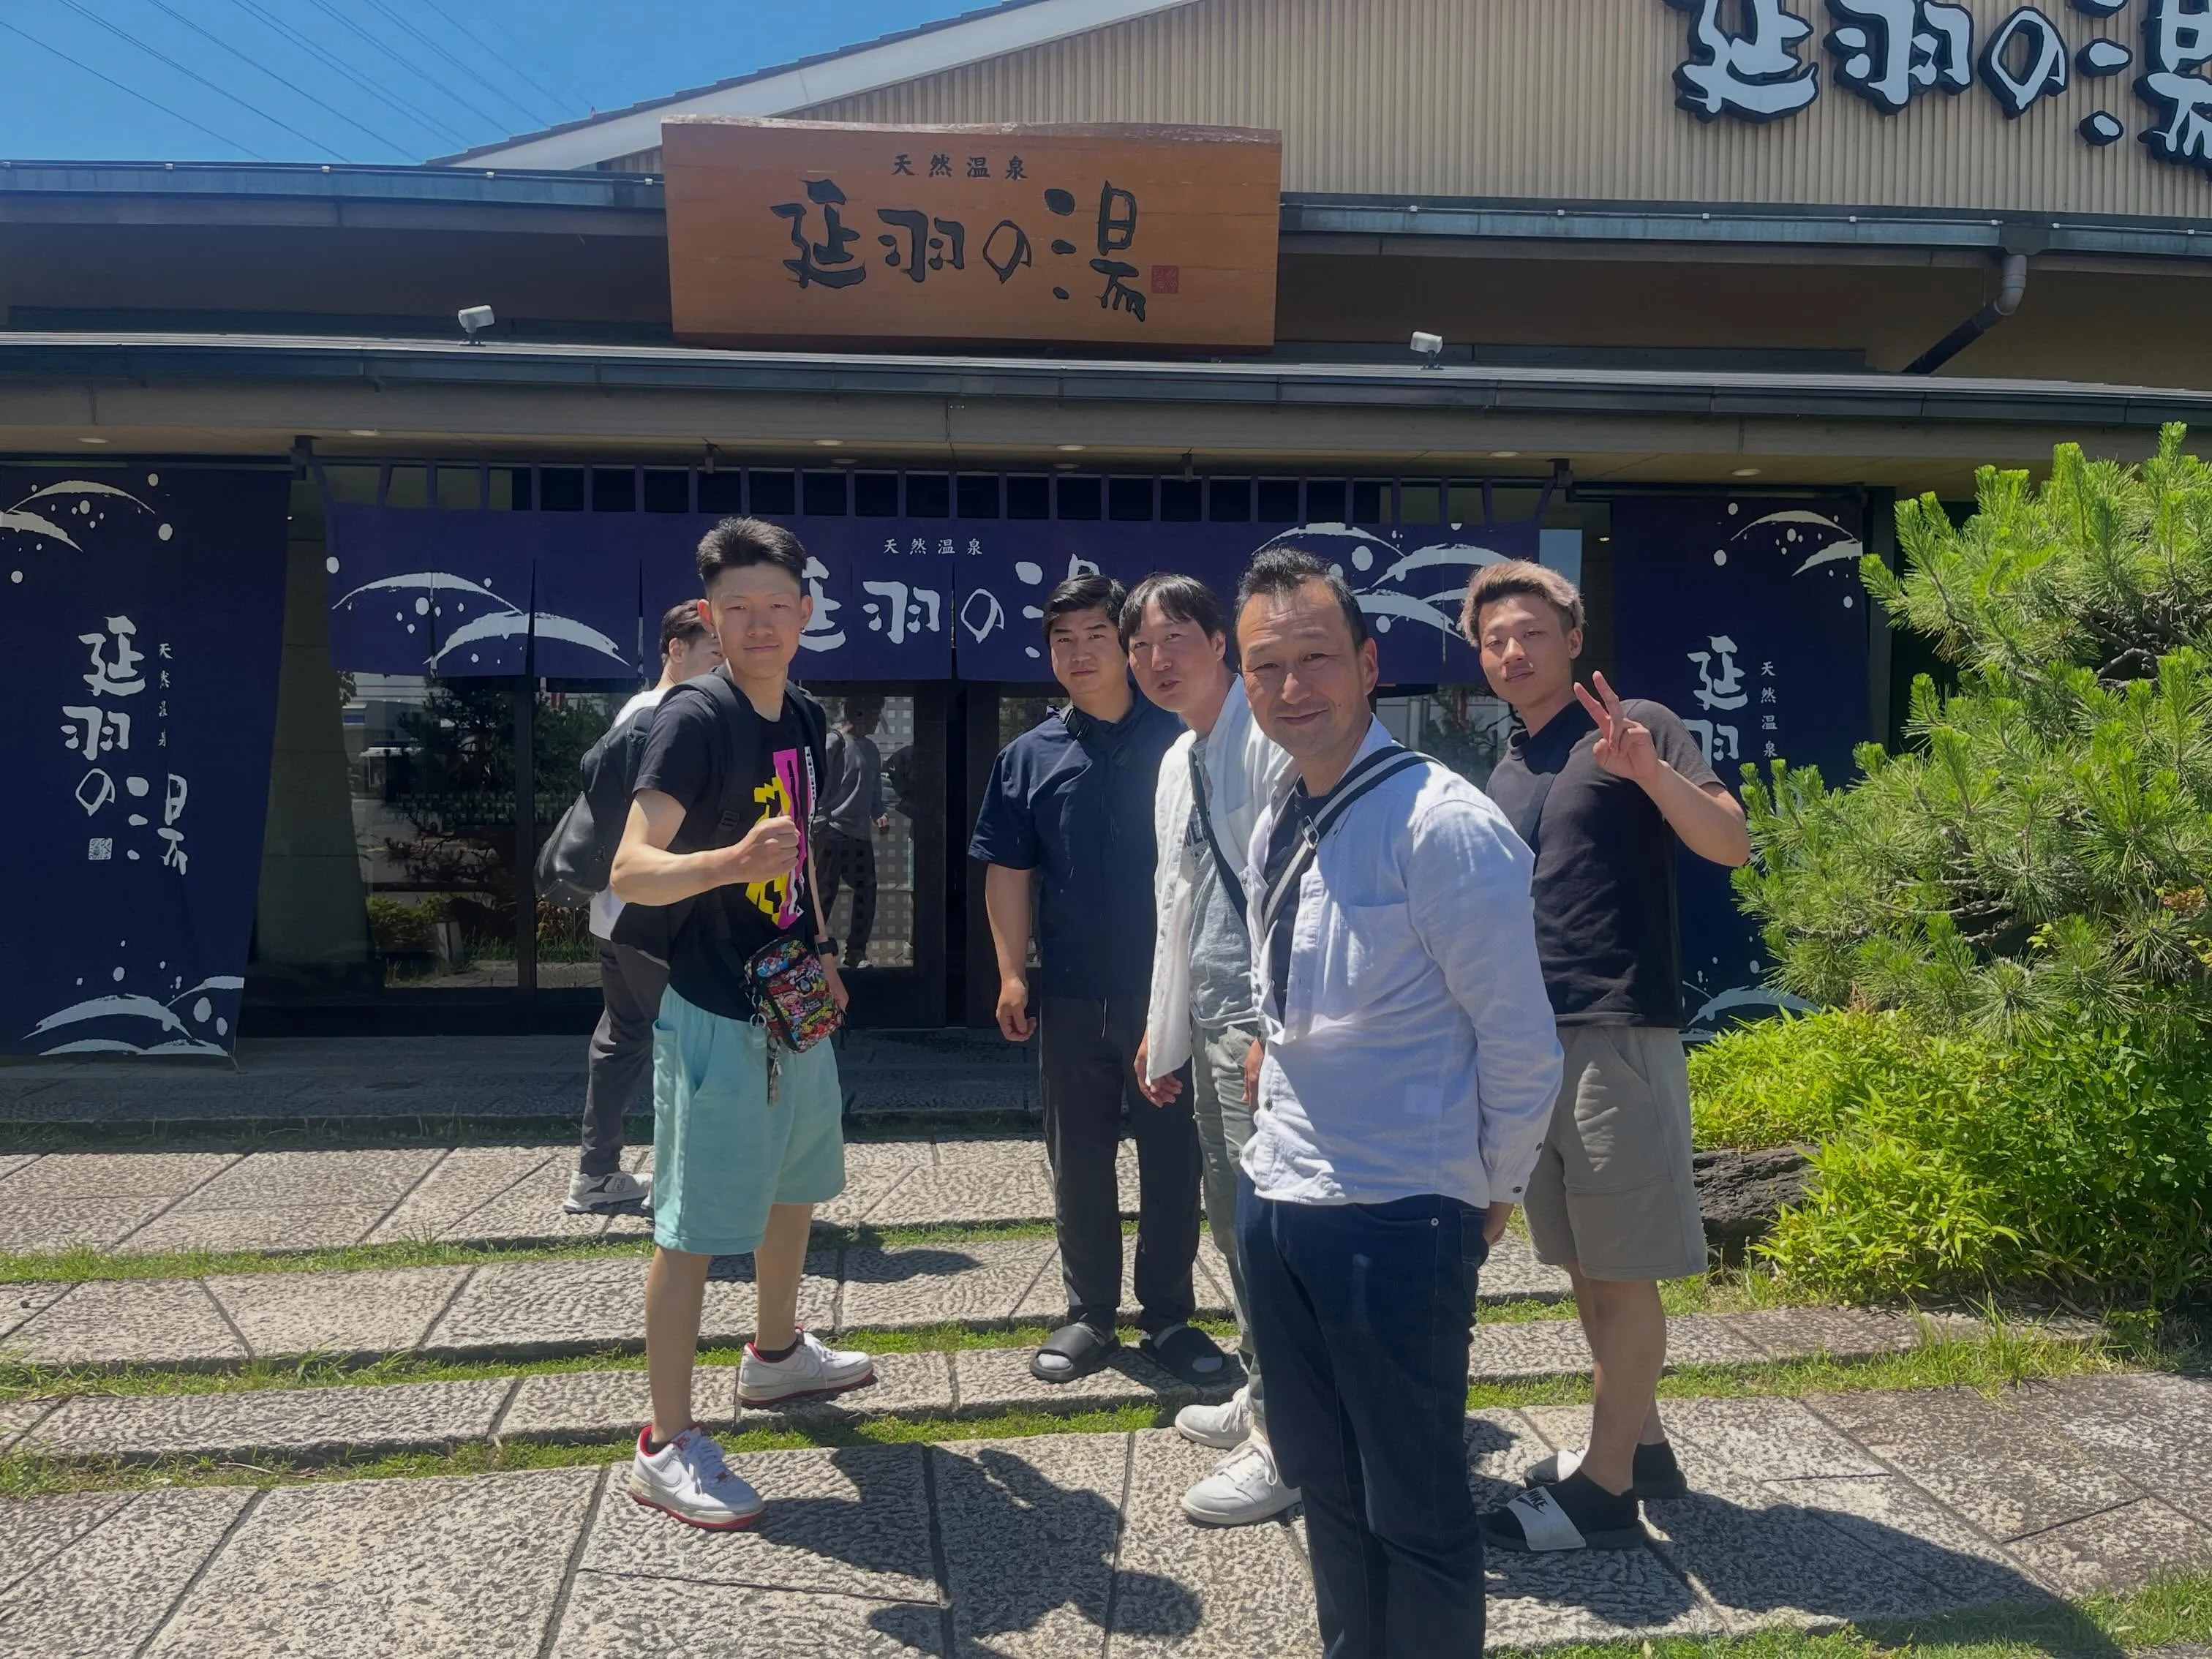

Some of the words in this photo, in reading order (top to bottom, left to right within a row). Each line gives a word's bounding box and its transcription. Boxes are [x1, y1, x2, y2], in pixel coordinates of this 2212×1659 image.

[892, 154, 1028, 179] 天然温泉
[770, 178, 1146, 322] 延羽の湯
[883, 538, 983, 556] 天然温泉
[1761, 661, 1778, 758] 天然温泉
